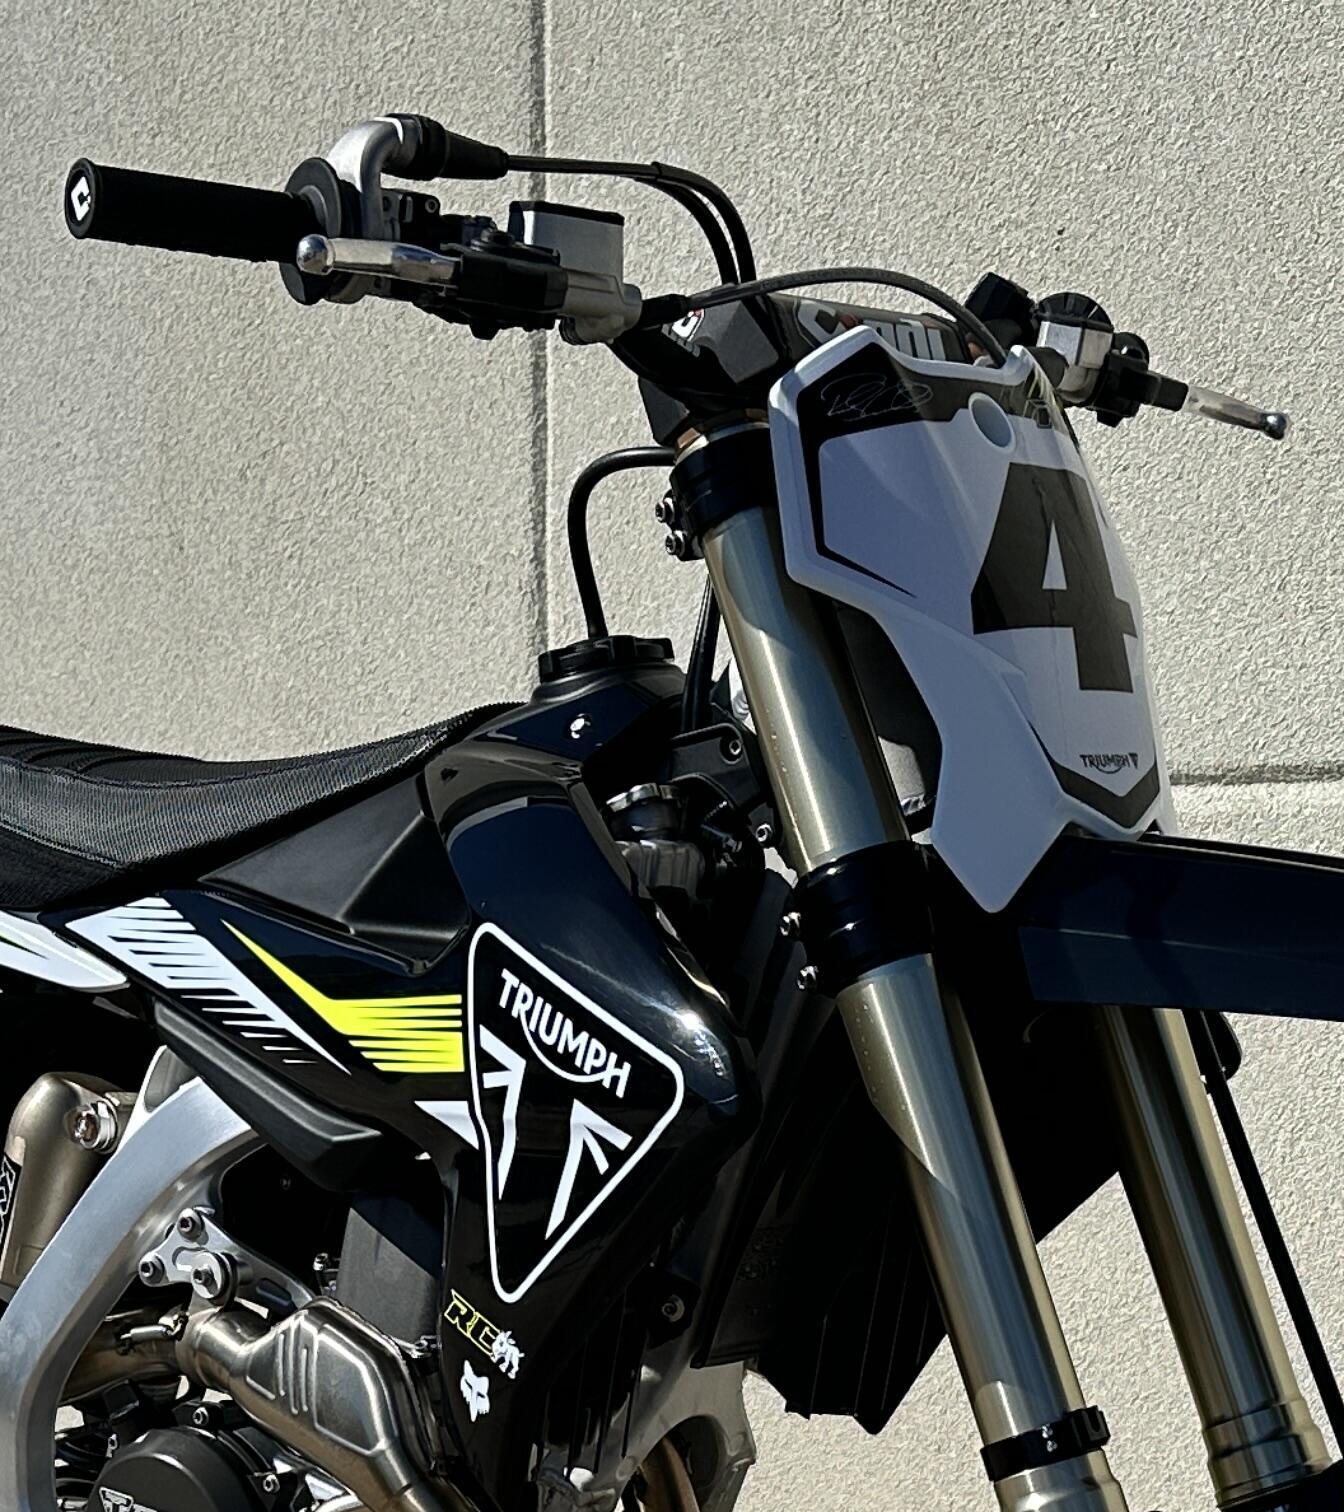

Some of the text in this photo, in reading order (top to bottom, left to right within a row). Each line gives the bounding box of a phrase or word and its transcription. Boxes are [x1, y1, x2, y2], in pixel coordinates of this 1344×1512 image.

[970, 462, 1139, 694] 4
[1079, 753, 1131, 774] TRIUMPH
[500, 967, 632, 1098] TRIUMPH
